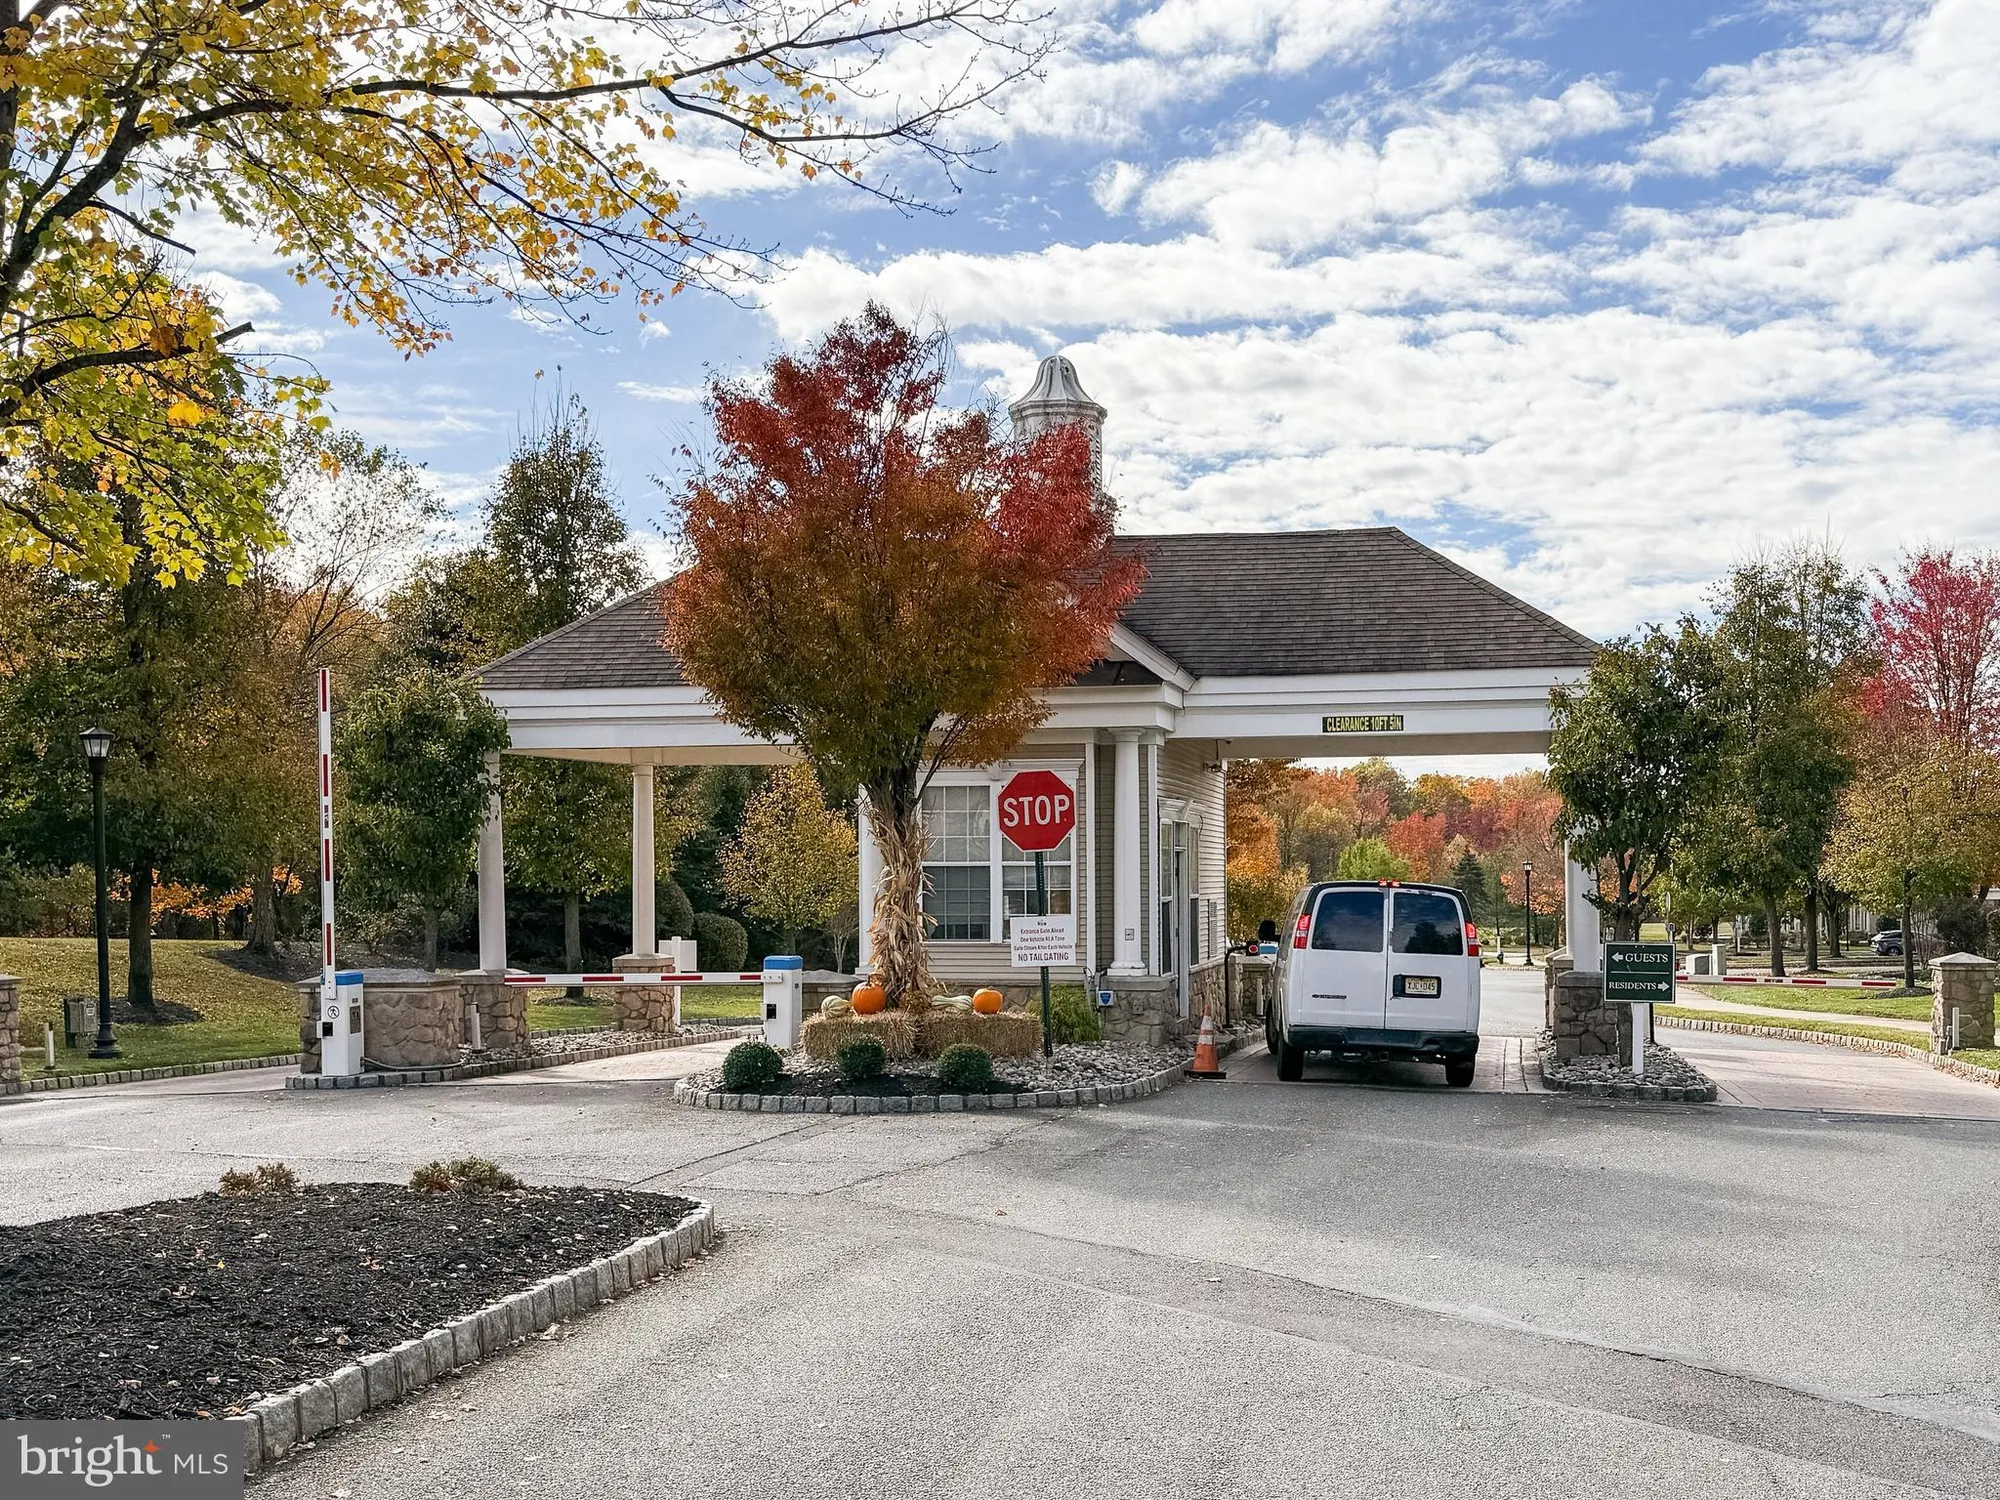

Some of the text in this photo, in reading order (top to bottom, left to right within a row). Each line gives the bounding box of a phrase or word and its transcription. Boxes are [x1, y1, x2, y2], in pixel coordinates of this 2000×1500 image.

[1326, 716, 1369, 732] CLEARANCE
[1003, 794, 1070, 827] STOP
[1018, 952, 1069, 961] NO TAILGATING
[1625, 953, 1669, 963] GUESTS
[1608, 981, 1657, 990] RESIDENTS
